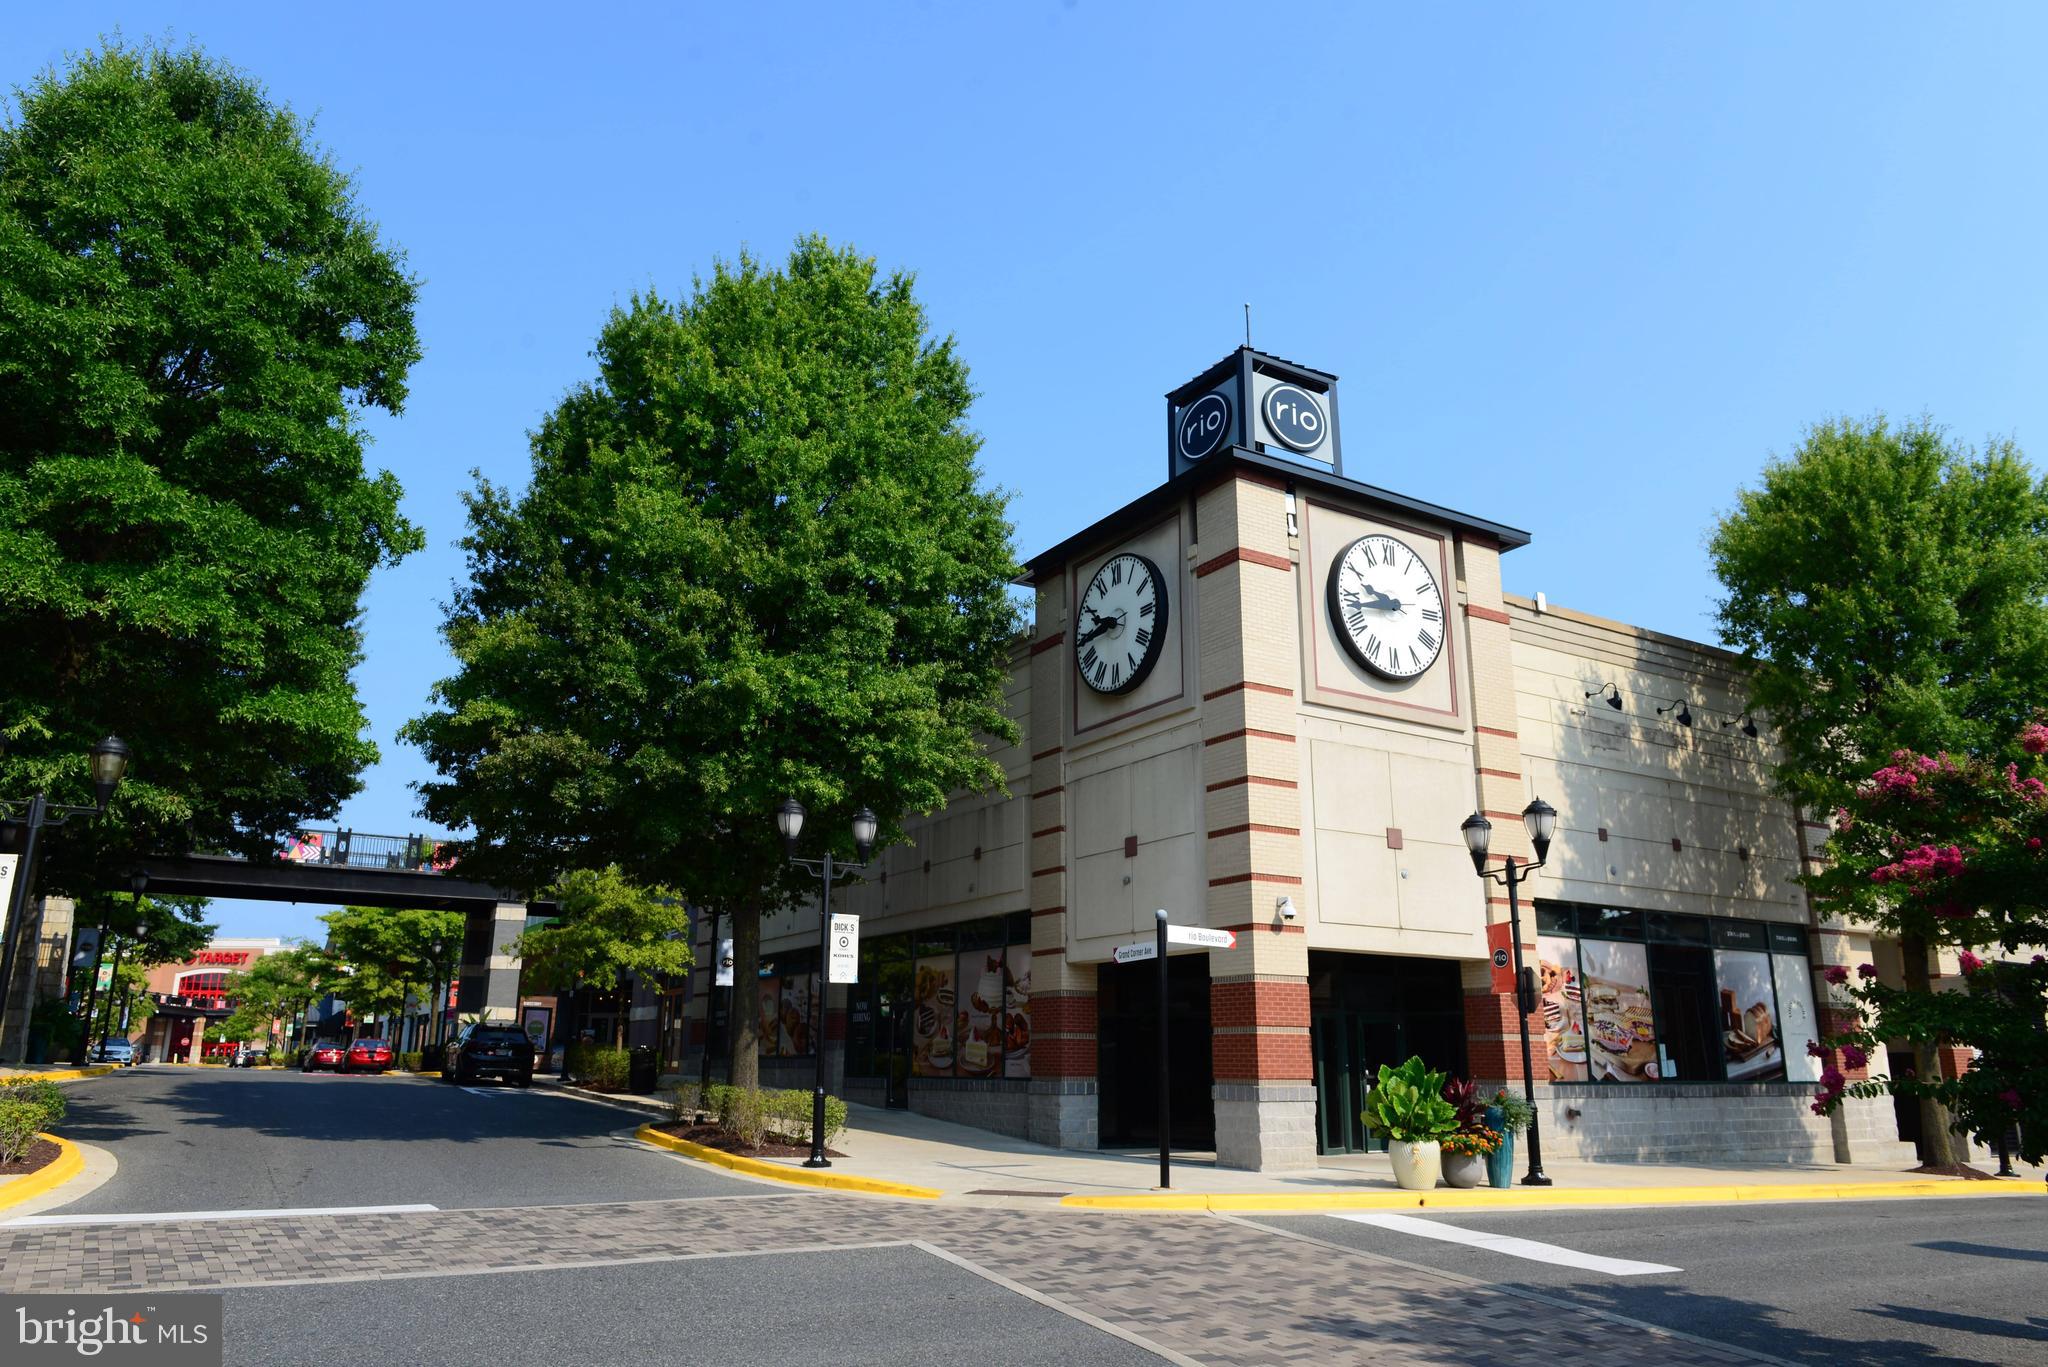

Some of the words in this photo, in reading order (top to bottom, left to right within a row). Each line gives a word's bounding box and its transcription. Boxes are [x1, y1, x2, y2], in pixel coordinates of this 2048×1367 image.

[1276, 400, 1318, 431] rio
[1187, 411, 1221, 444] rio
[1361, 544, 1377, 568] XI
[1381, 543, 1396, 567] XII
[1347, 562, 1364, 581] X
[1416, 583, 1431, 594] II
[1347, 611, 1368, 637] VIII
[1422, 609, 1438, 621] III
[1365, 634, 1381, 659] VII
[1417, 628, 1436, 651] IIII
[1388, 646, 1400, 670] VI
[1408, 645, 1421, 666] V
[834, 922, 855, 932] DICKS
[1198, 932, 1227, 944] Boulevard
[199, 951, 249, 965] TARGET
[1118, 949, 1130, 959] Grand
[1130, 948, 1143, 957] Corner
[1144, 947, 1152, 955] Ave
[1494, 954, 1507, 962] rio
[856, 1001, 868, 1011] NOW
